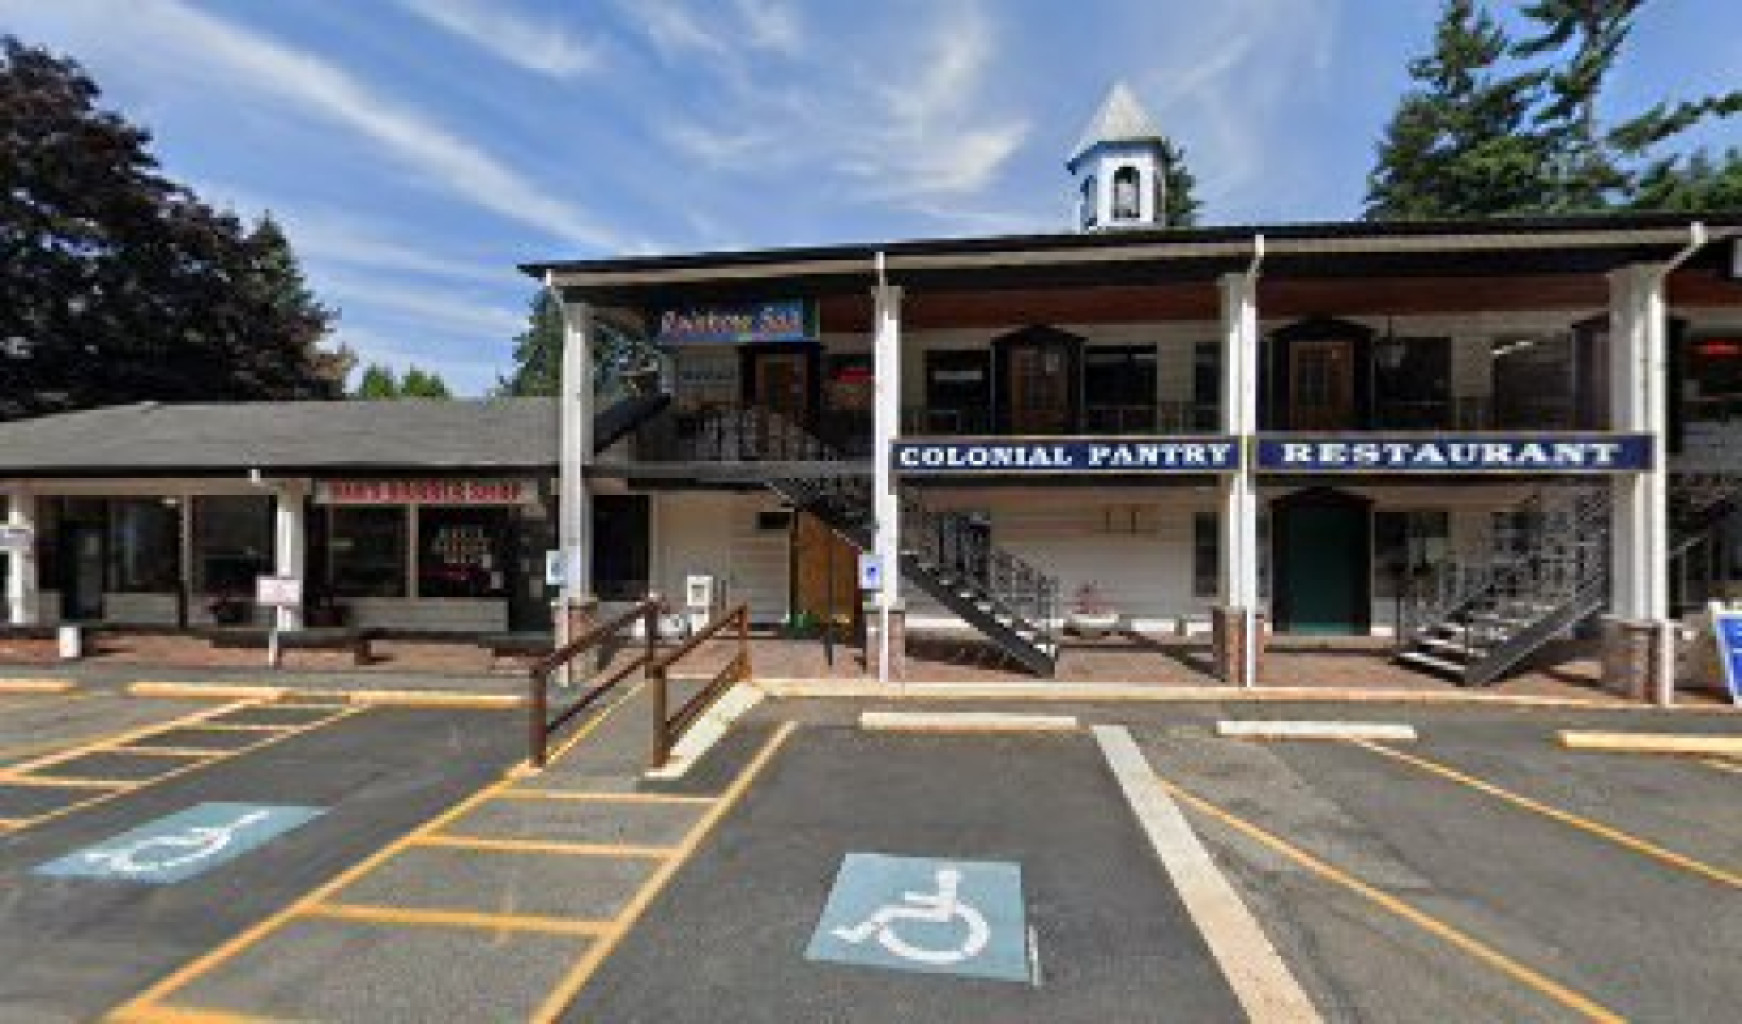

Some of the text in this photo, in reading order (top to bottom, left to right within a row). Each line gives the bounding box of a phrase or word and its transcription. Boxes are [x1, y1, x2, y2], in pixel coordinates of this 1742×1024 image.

[900, 443, 1231, 467] COLONIAL PANTRY
[1281, 442, 1622, 464] RESTAURANT
[467, 480, 522, 502] SHOP
